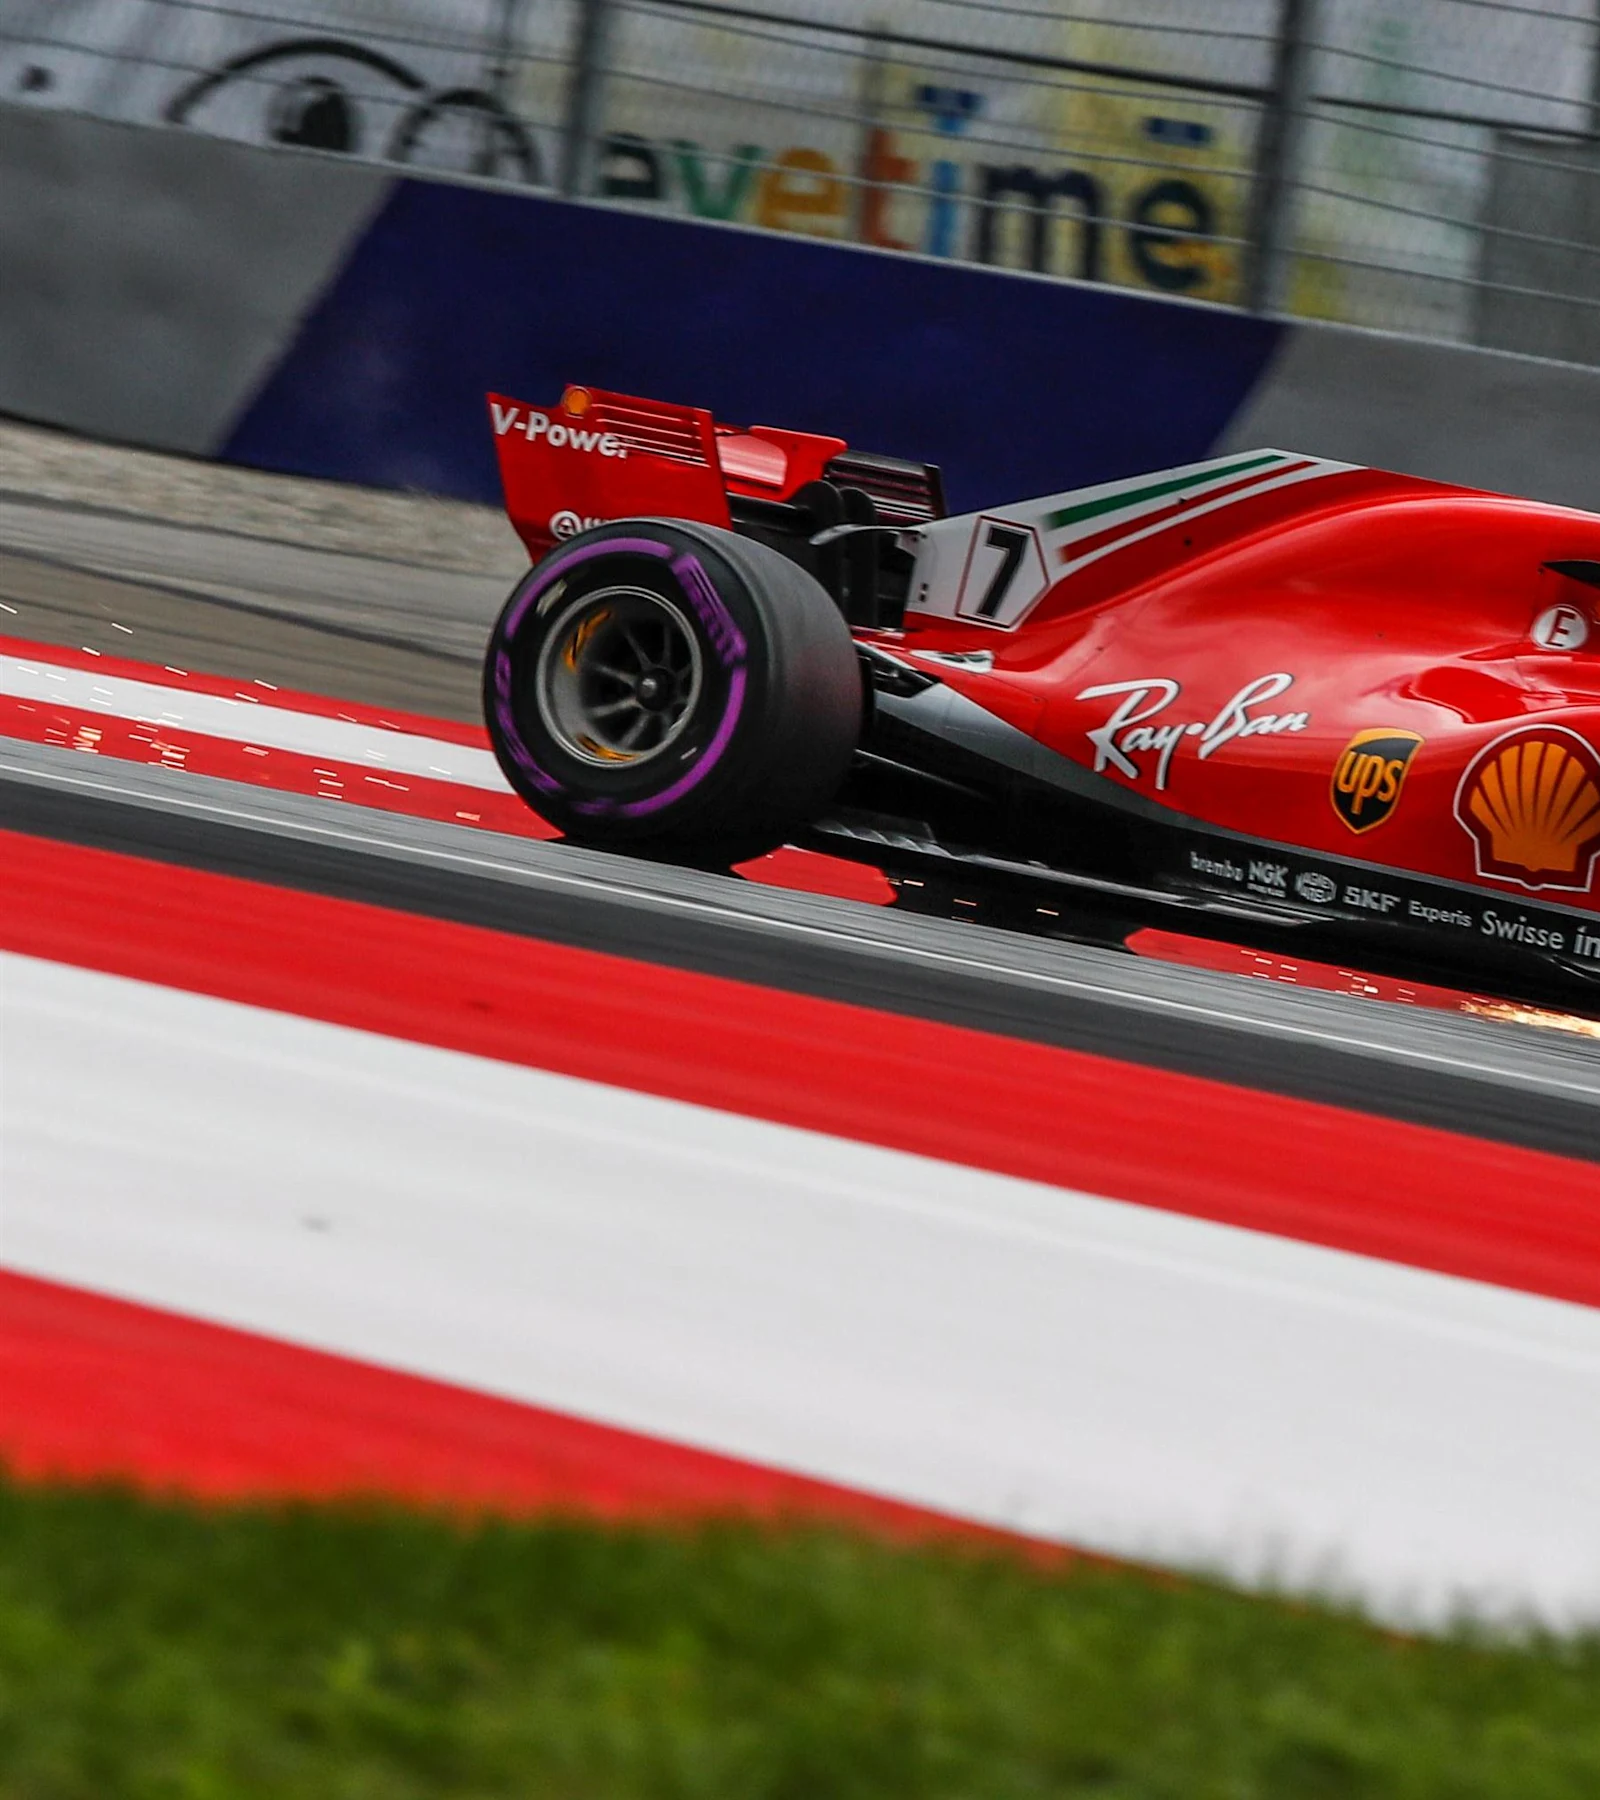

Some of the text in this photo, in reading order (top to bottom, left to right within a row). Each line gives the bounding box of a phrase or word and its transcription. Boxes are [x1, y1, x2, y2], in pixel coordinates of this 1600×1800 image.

[977, 525, 1031, 618] 7
[1546, 607, 1577, 647] E
[1249, 860, 1289, 889] NGK
[1342, 886, 1401, 913] SKF
[1408, 900, 1473, 924] Experis
[1480, 910, 1565, 950] Swisse
